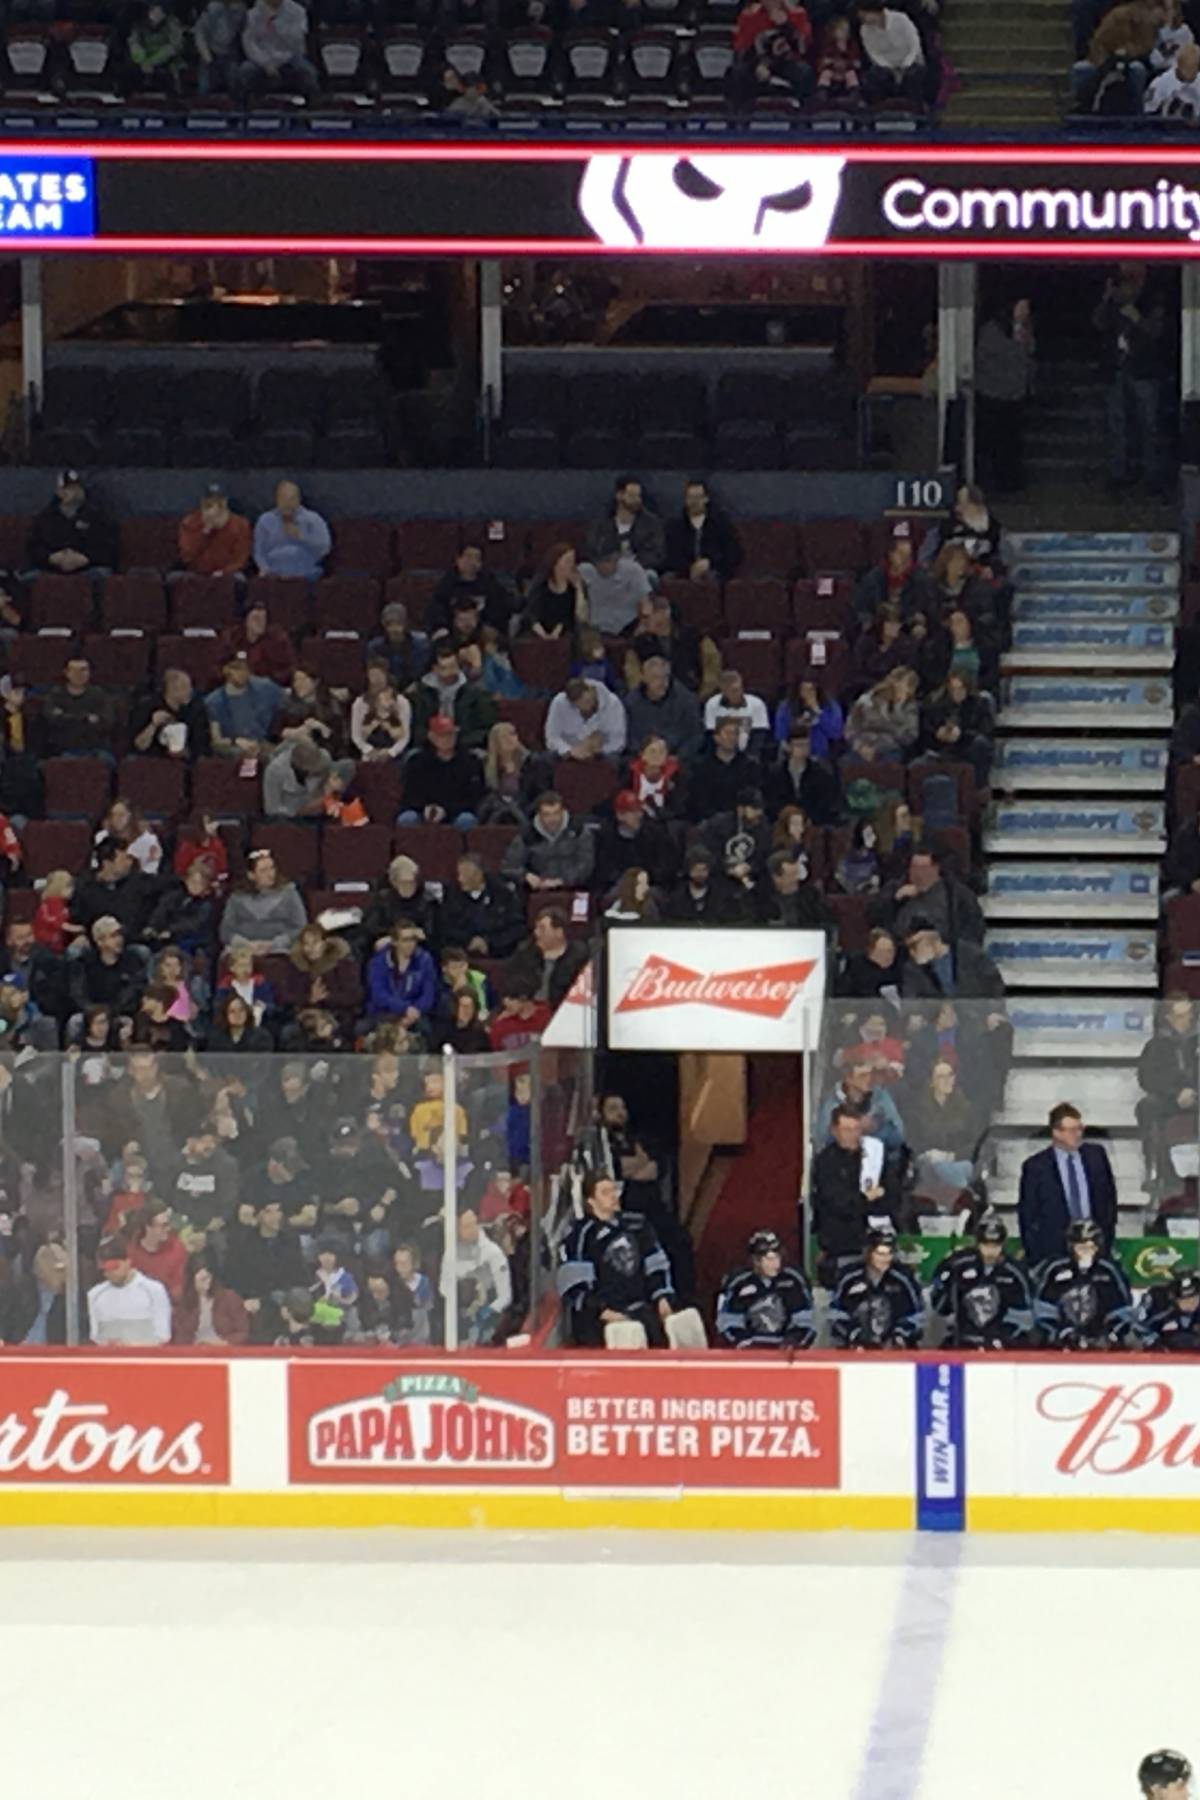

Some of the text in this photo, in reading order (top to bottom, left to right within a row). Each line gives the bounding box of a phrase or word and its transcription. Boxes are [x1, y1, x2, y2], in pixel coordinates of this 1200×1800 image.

[0, 203, 62, 230] AM
[896, 480, 942, 507] 110
[624, 963, 803, 1001] Budweiser
[400, 1375, 462, 1393] PIZZA
[566, 1397, 821, 1422] BETTER INGREDIENTS.
[315, 1402, 549, 1463] PAPA JOHNS
[566, 1423, 822, 1458] BETTER PIZZA.
